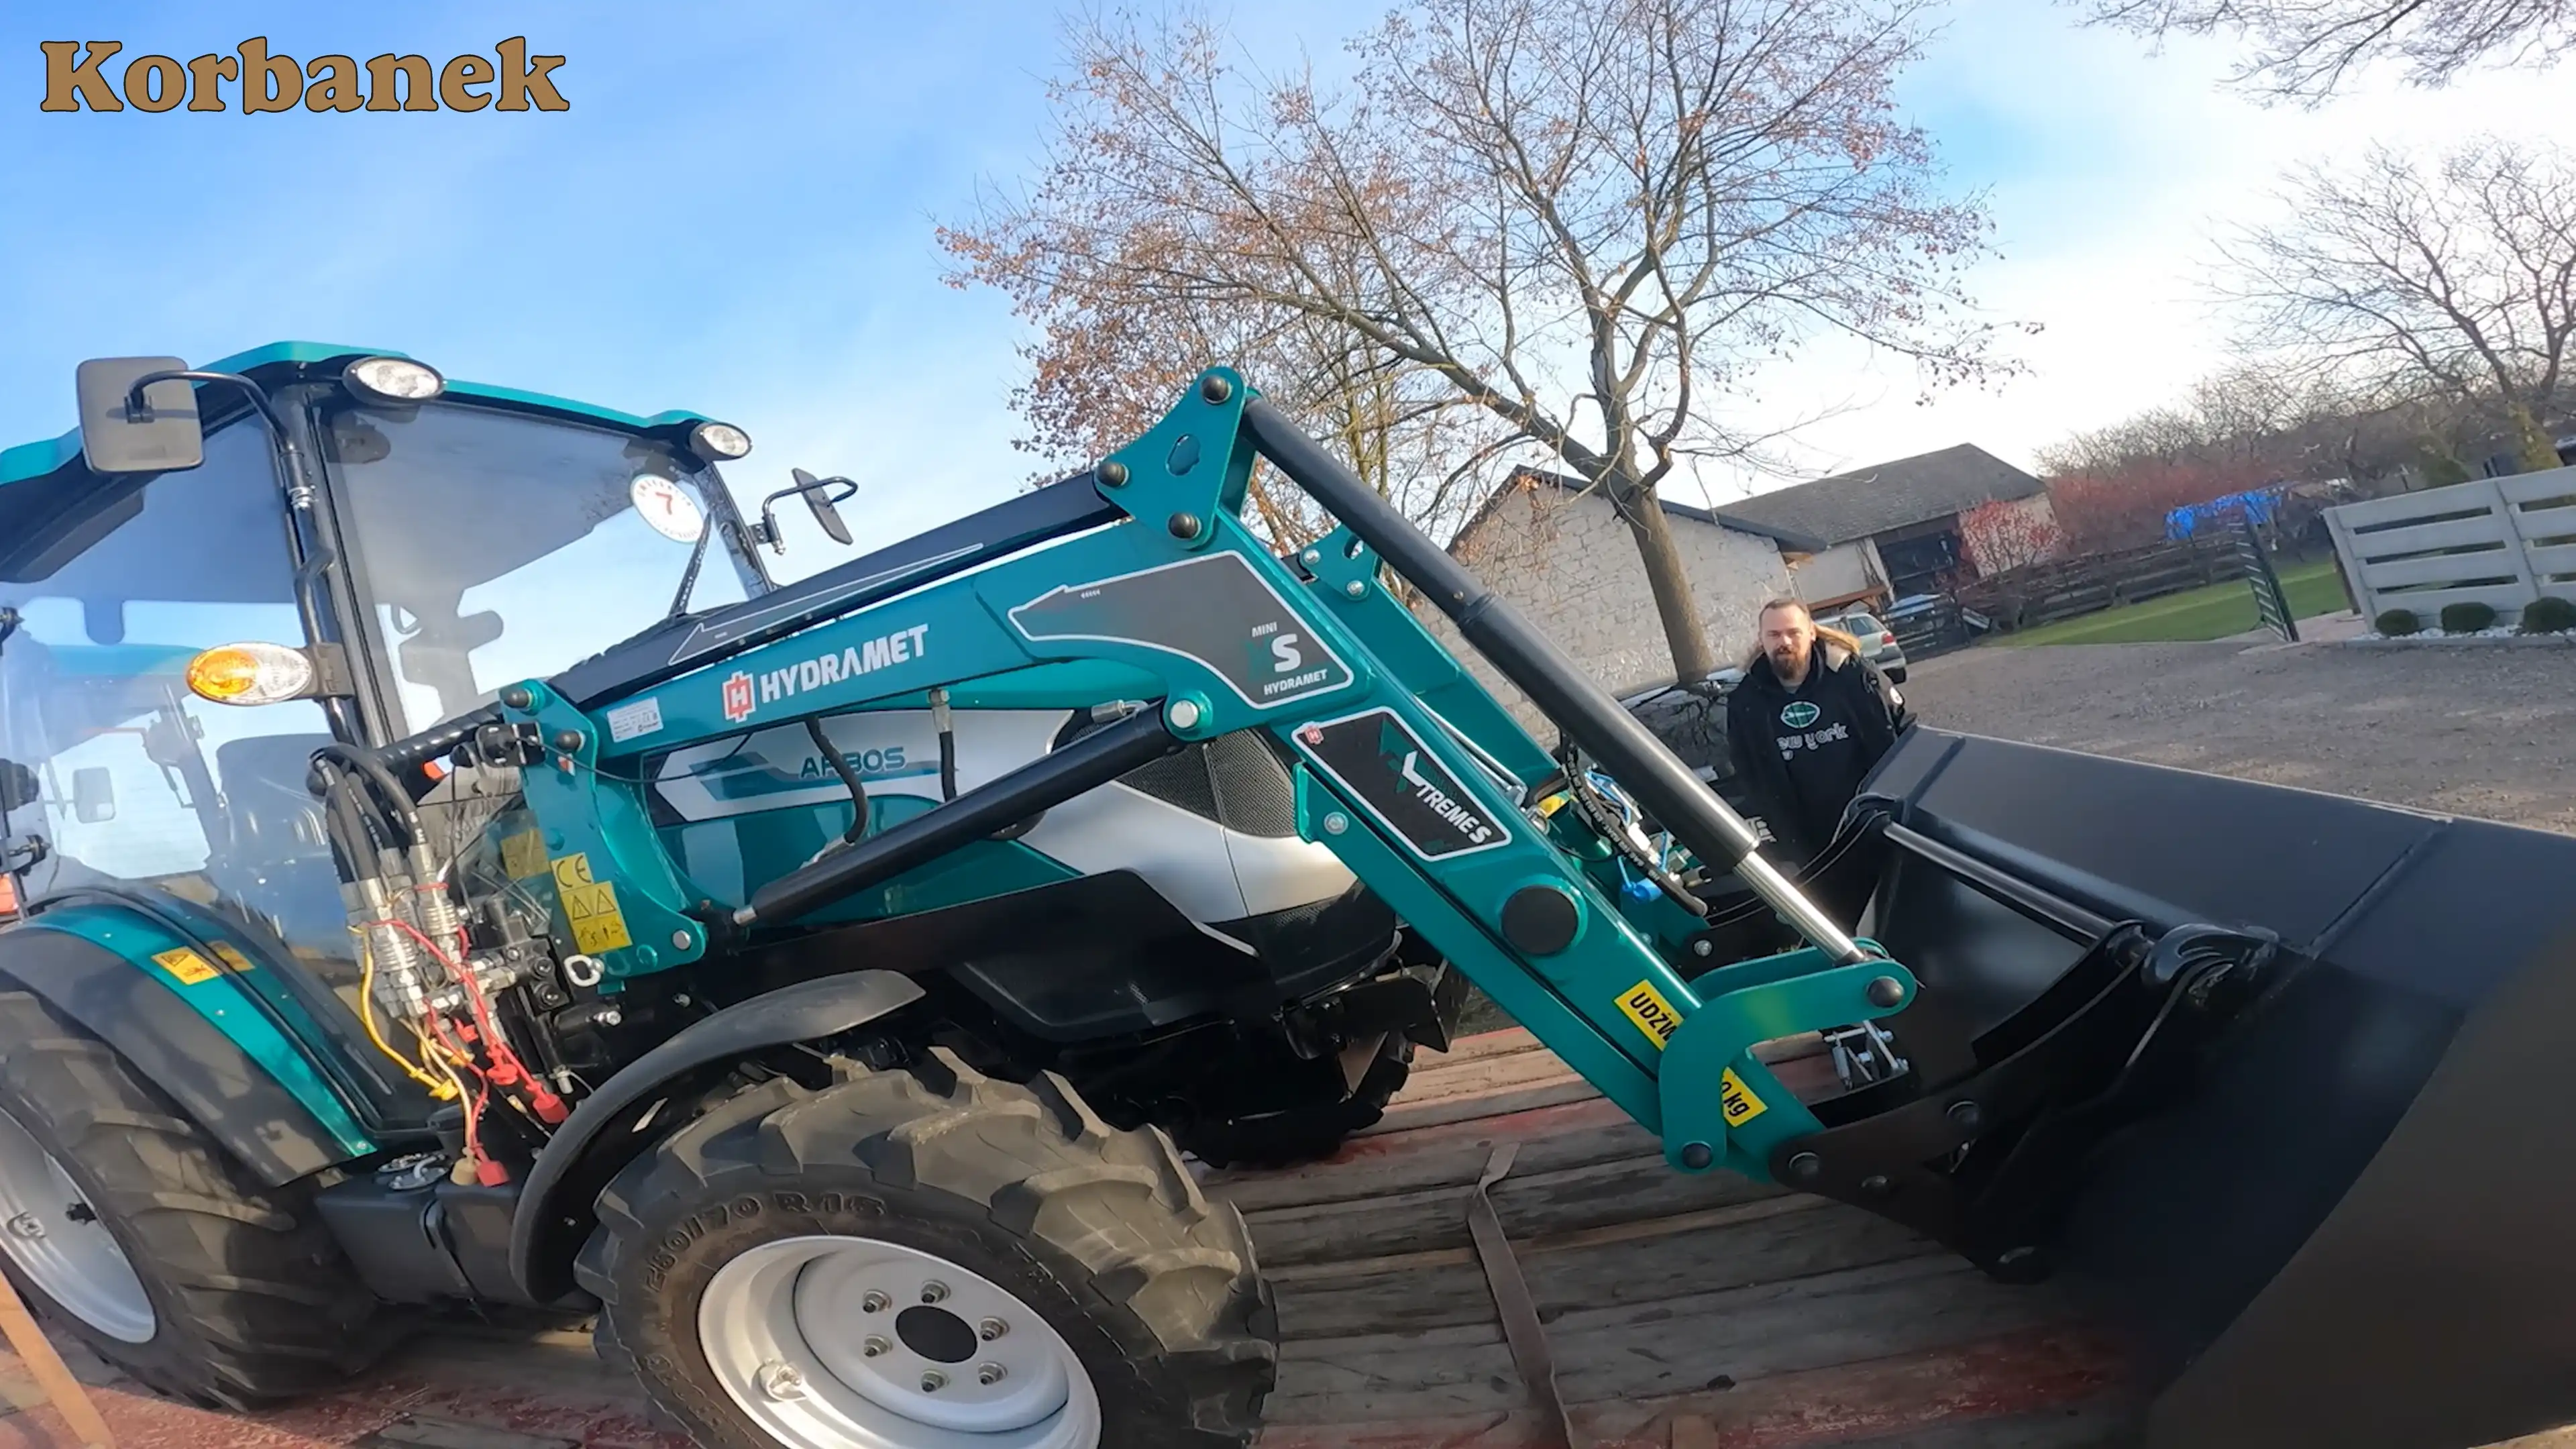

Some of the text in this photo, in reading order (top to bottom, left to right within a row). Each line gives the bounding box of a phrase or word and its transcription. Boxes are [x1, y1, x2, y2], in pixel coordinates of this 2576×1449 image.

[1251, 621, 1277, 638] MINI
[759, 623, 928, 703] HYDRAMET
[1263, 668, 1328, 695] HYDRAMET
[1805, 722, 1849, 750] york
[1723, 1091, 1750, 1116] kg
